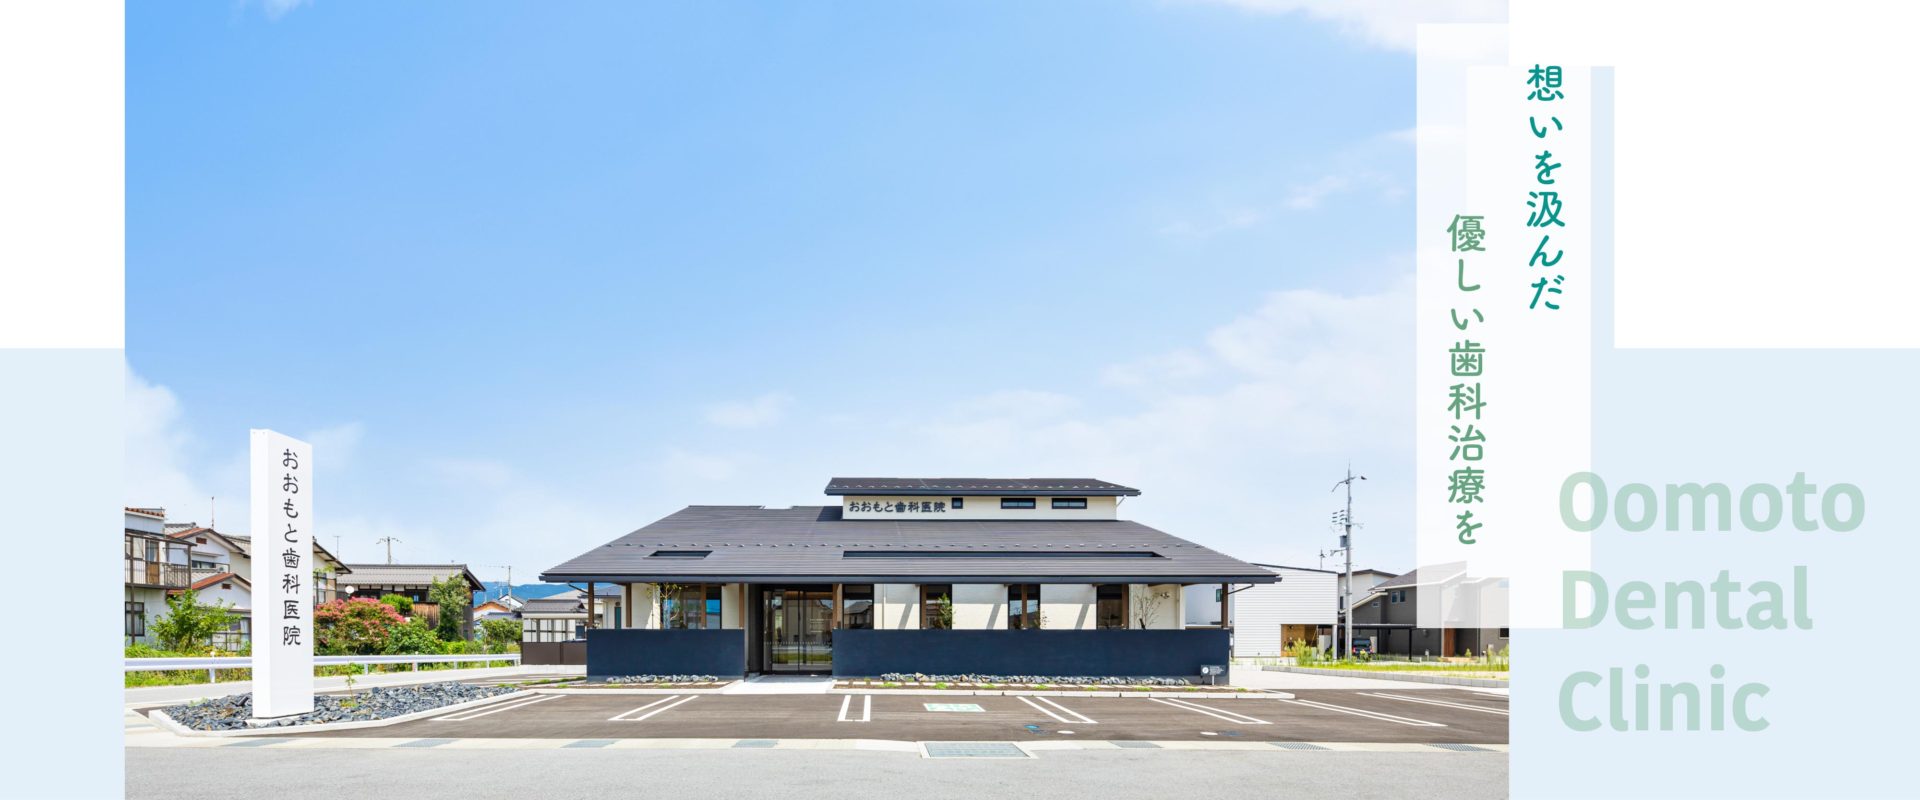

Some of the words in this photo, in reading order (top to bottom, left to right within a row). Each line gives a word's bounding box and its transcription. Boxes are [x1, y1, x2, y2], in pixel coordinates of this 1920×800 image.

[282, 448, 301, 645] おおもと歯科医院
[849, 501, 946, 512] おおもと歯科医院
